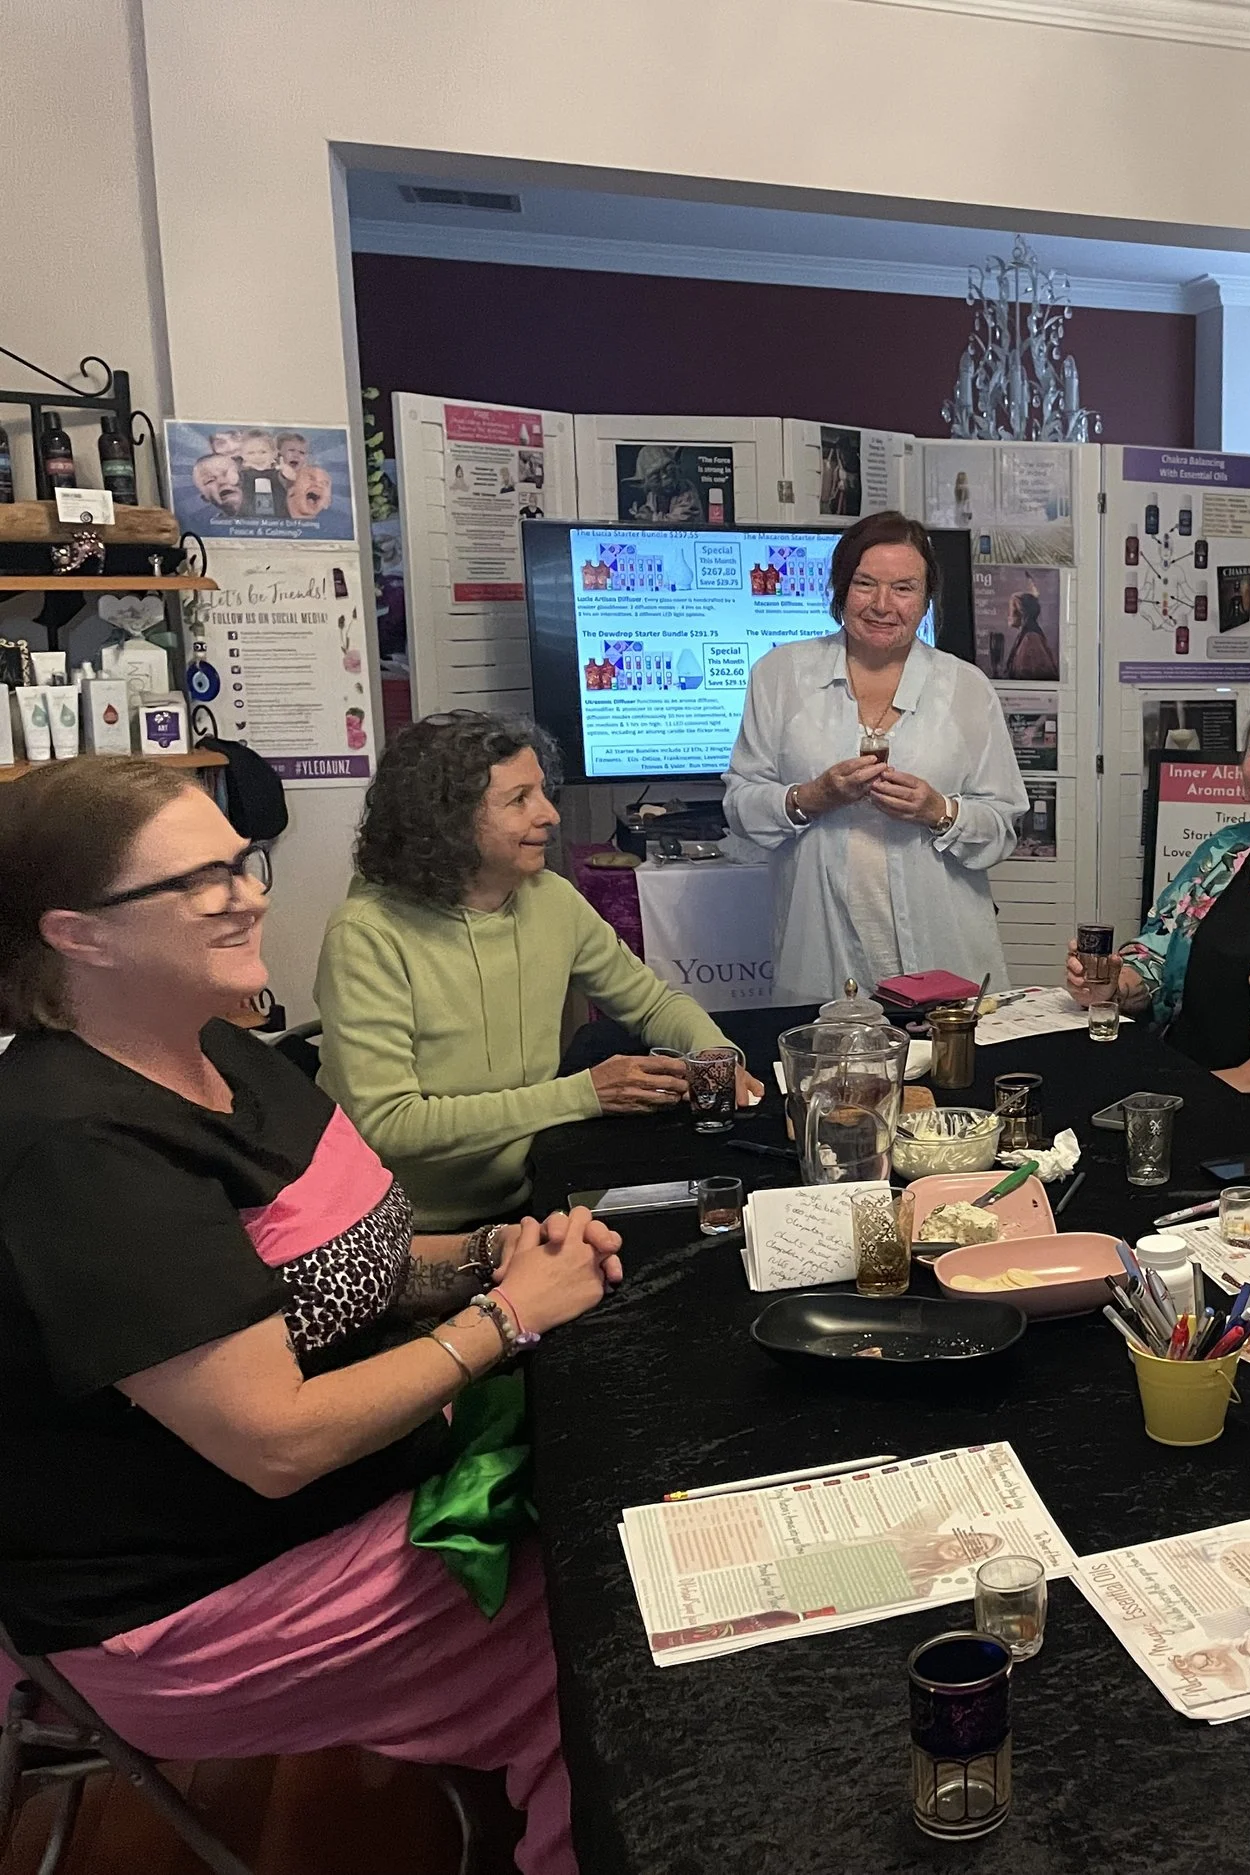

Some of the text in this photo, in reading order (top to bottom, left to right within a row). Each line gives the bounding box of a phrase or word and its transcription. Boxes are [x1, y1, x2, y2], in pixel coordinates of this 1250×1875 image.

[1161, 455, 1225, 469] Chakra Balancing
[1160, 468, 1228, 481] With Essential Oils
[702, 546, 733, 555] Special
[714, 557, 737, 565] Month
[701, 567, 736, 577] $267.80
[210, 578, 327, 608] Let's be Friends!
[213, 612, 328, 624] FOLLOW US ON SOCIAL MEDIA!
[583, 630, 597, 638] The
[600, 630, 633, 639] Dewdrop
[746, 628, 760, 636] The
[800, 629, 823, 637] Starter
[710, 647, 741, 656] Special
[710, 668, 744, 677] $262.60
[295, 759, 351, 776] #YLEOAUNZ
[1169, 764, 1207, 778] Inner
[1216, 812, 1246, 823] Tired
[1163, 846, 1192, 857] Love
[1088, 1562, 1117, 1583] Oils
[1098, 1580, 1148, 1621] Essential
